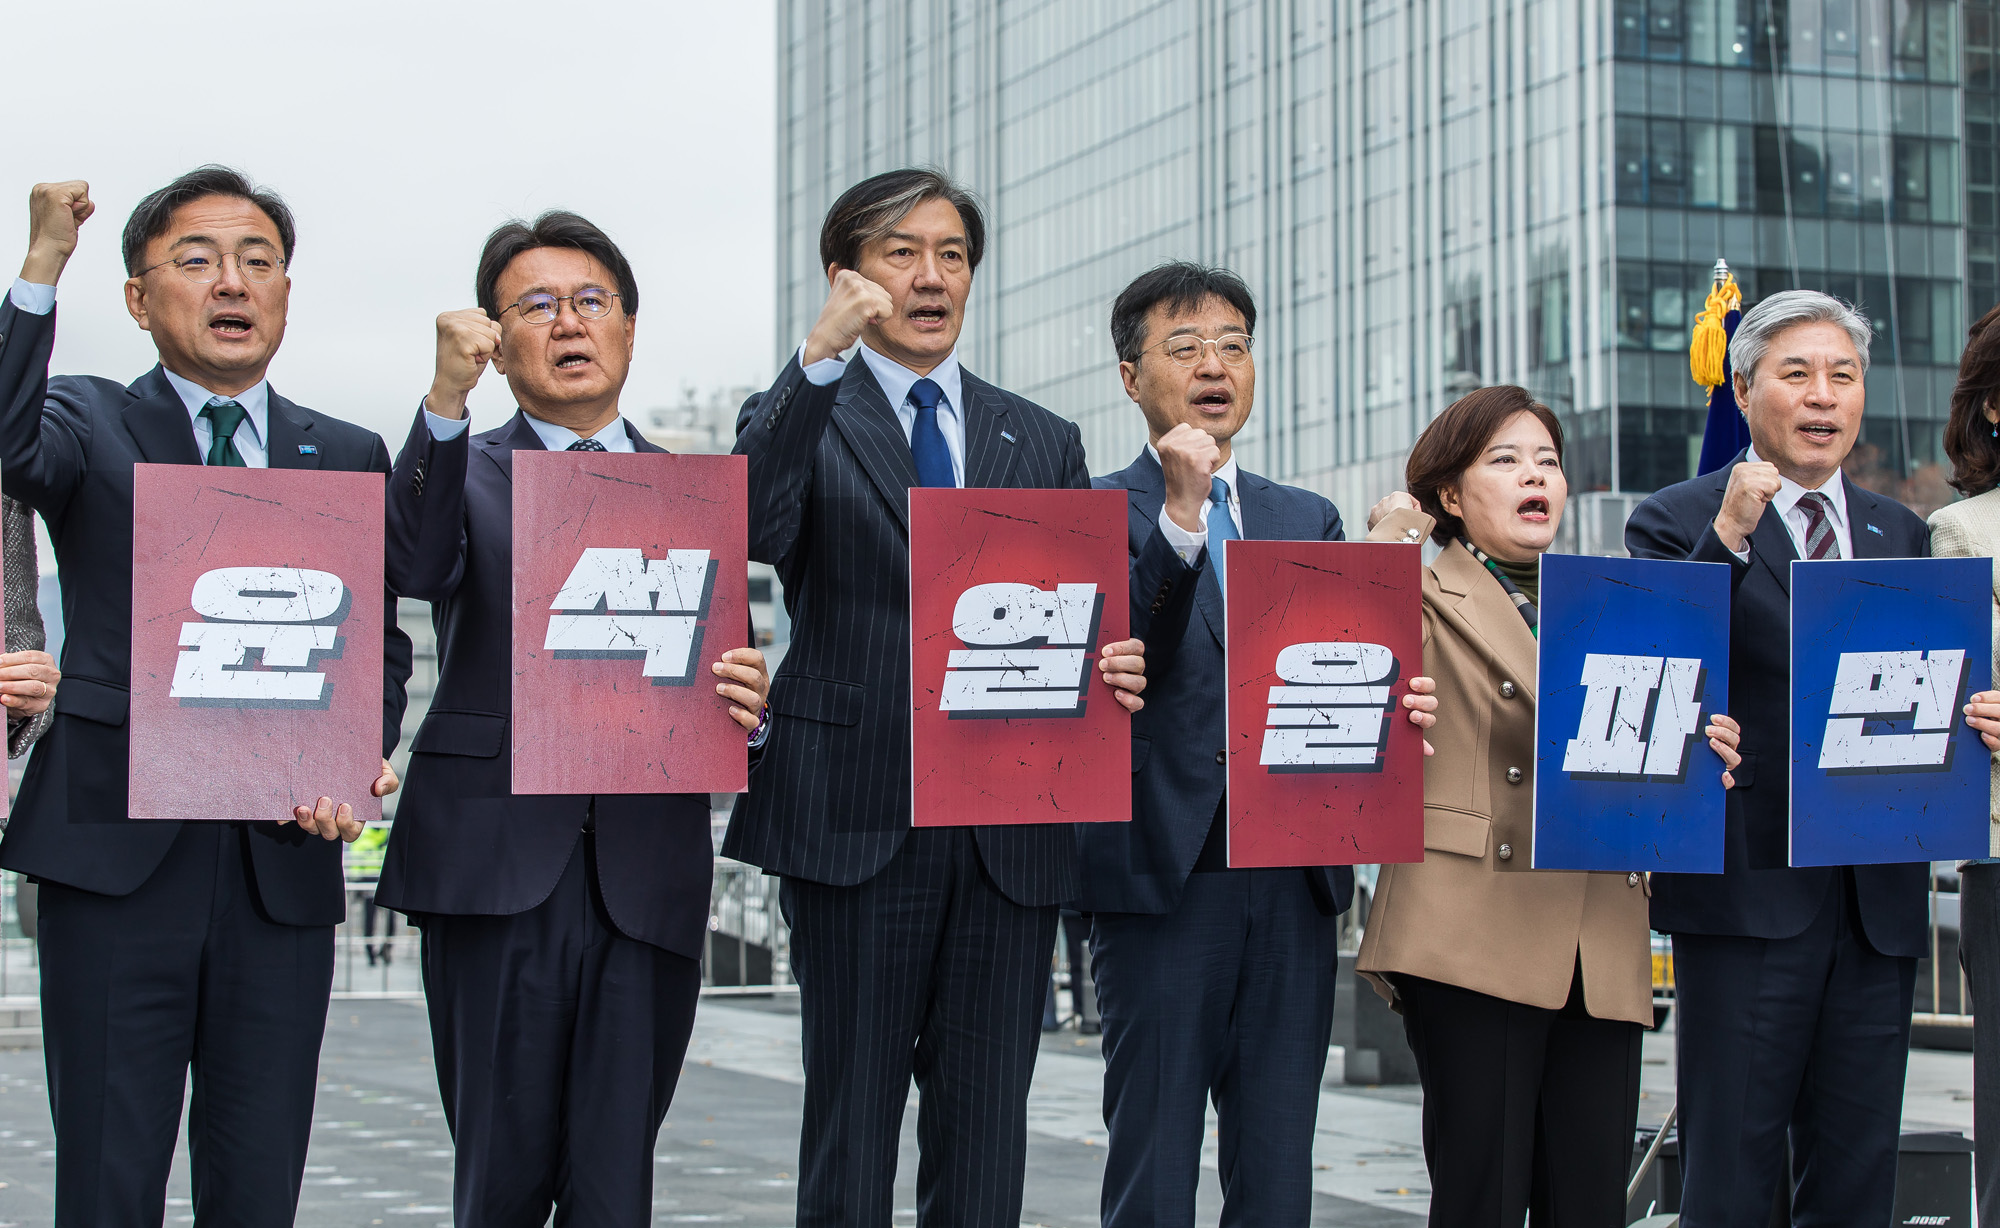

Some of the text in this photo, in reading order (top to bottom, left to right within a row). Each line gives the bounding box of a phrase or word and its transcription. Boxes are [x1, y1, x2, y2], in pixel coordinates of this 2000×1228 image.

[169, 567, 343, 700] 윤
[544, 548, 710, 676] 석
[939, 583, 1097, 710] 열
[1260, 642, 1392, 765] 을
[1563, 654, 1701, 775] 파
[1818, 650, 1965, 768] 면
[1902, 1215, 1951, 1226] BOSE
